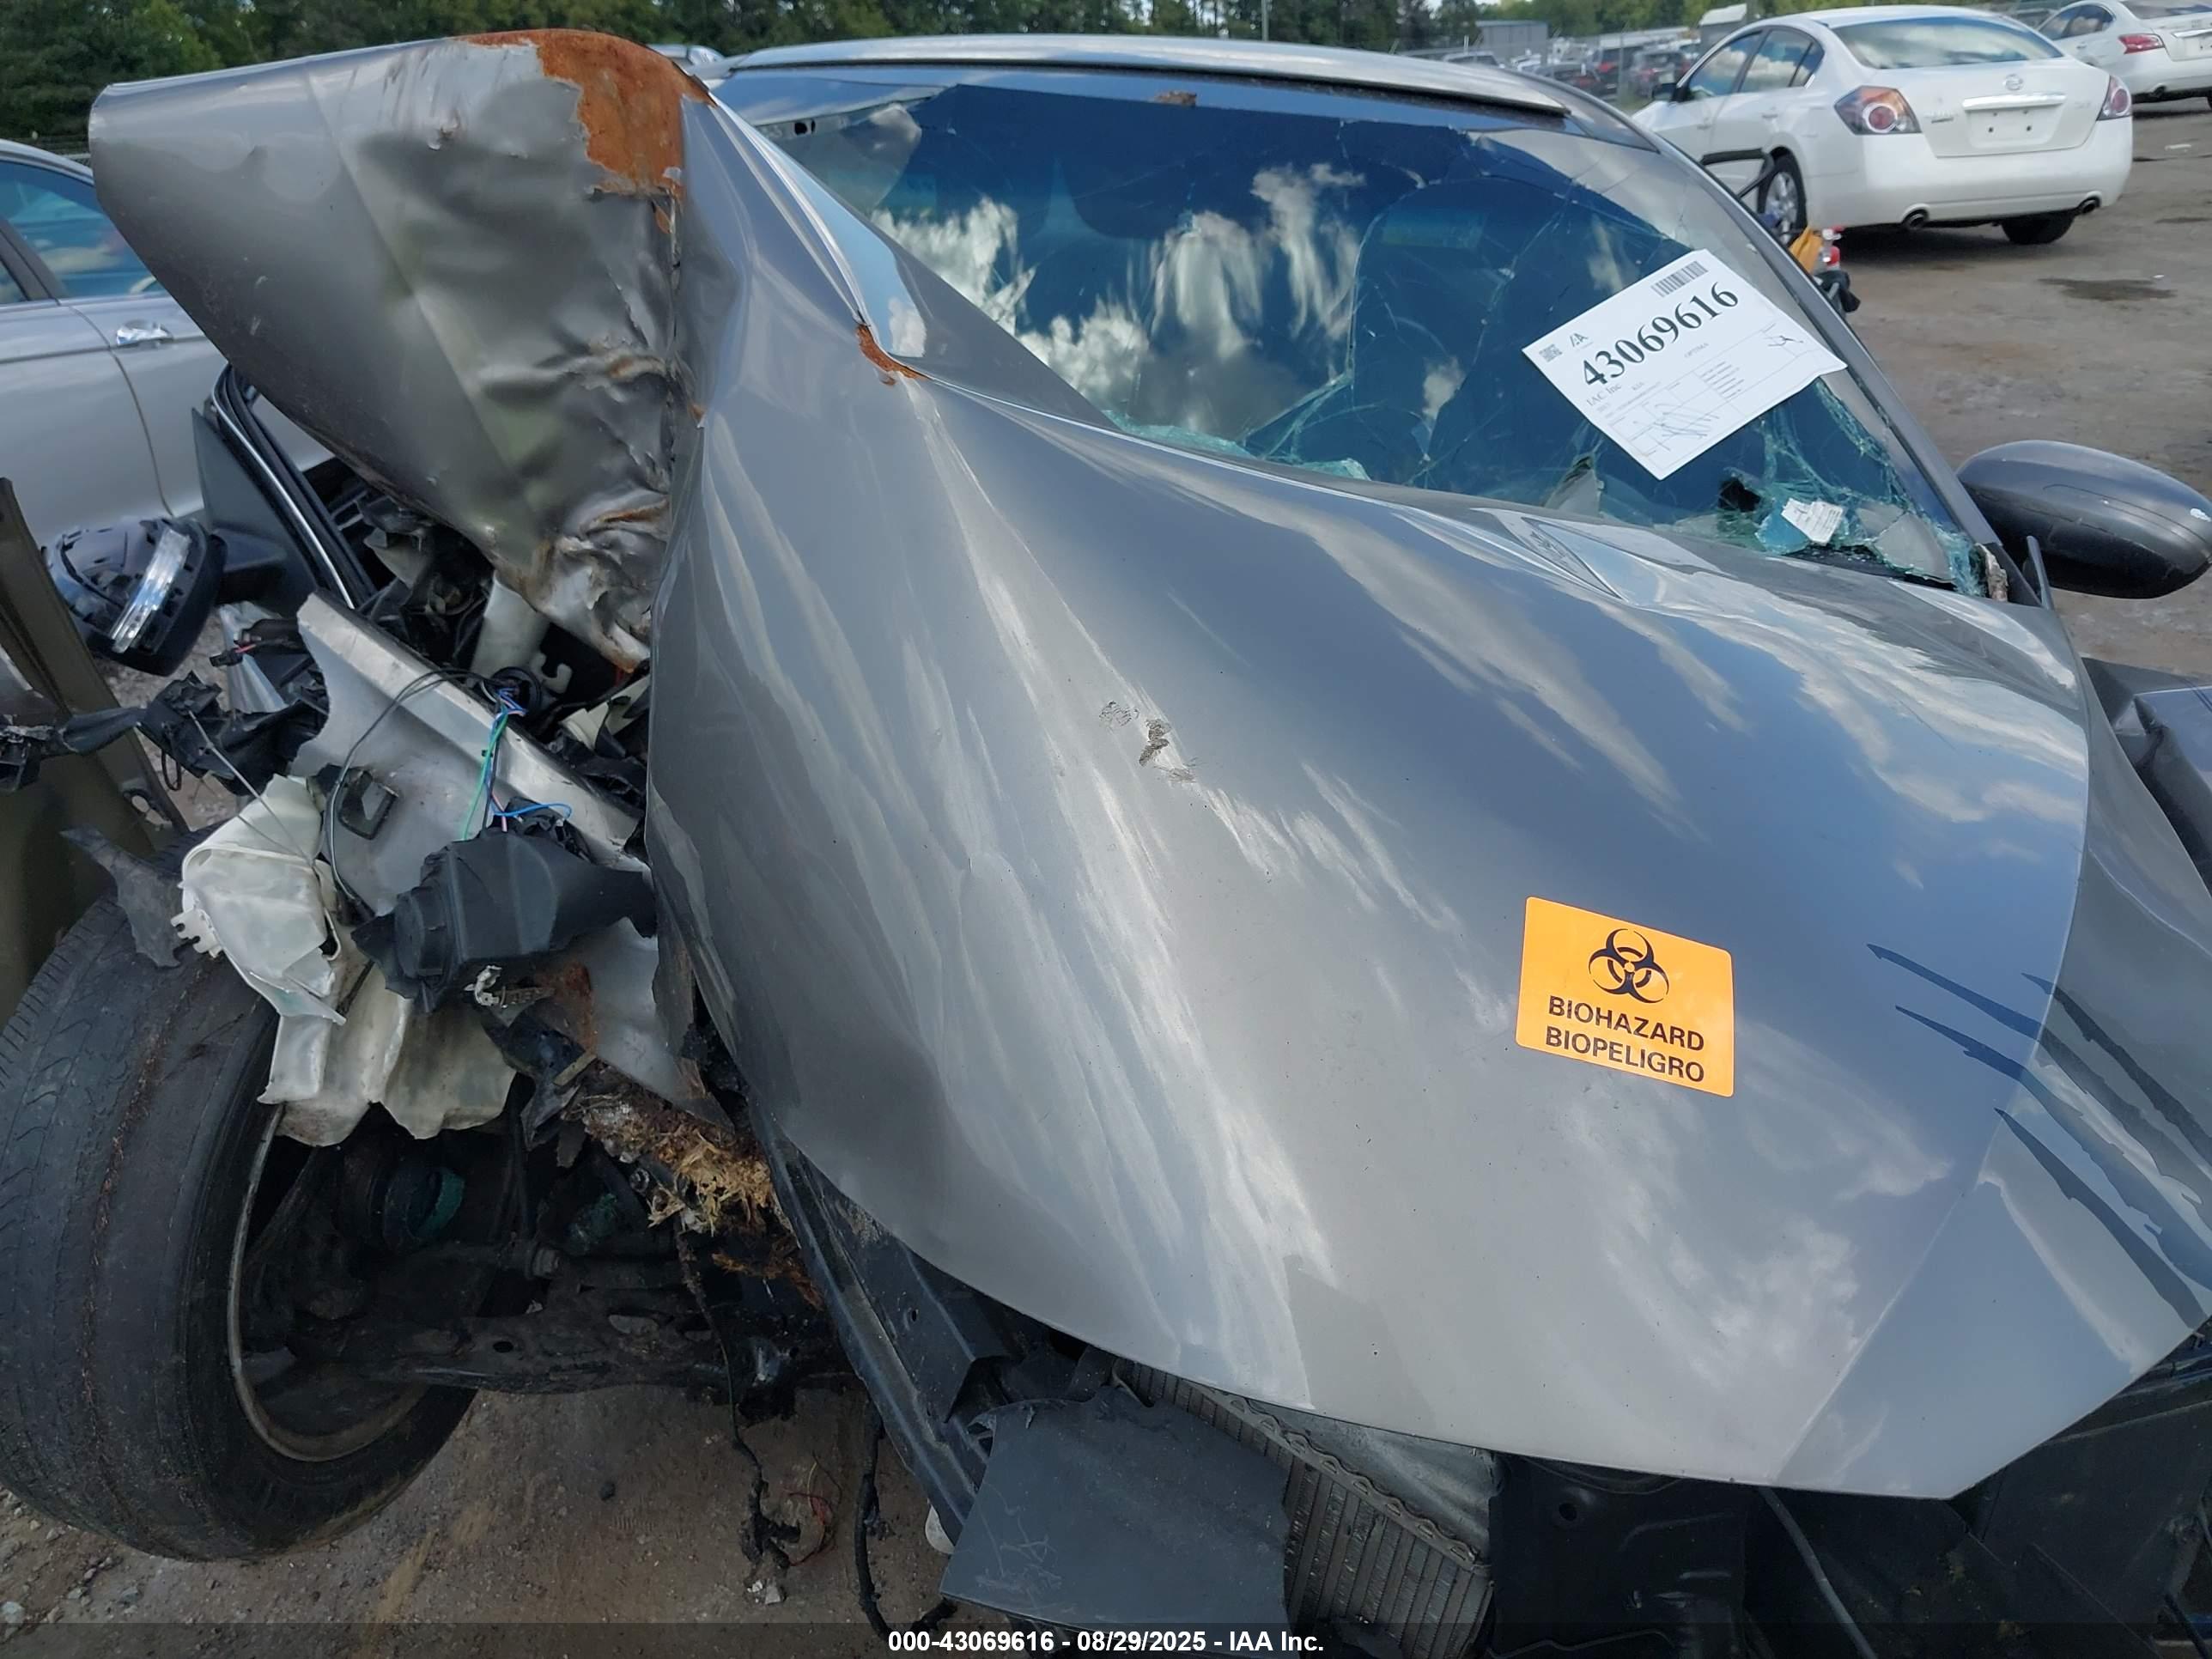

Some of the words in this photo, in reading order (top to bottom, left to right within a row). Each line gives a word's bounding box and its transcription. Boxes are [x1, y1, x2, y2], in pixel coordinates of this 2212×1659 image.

[1583, 282, 1739, 385] 43069616
[1548, 995, 1705, 1051] BIOHAZARD
[1546, 1026, 1705, 1082] BIOPELIGRO
